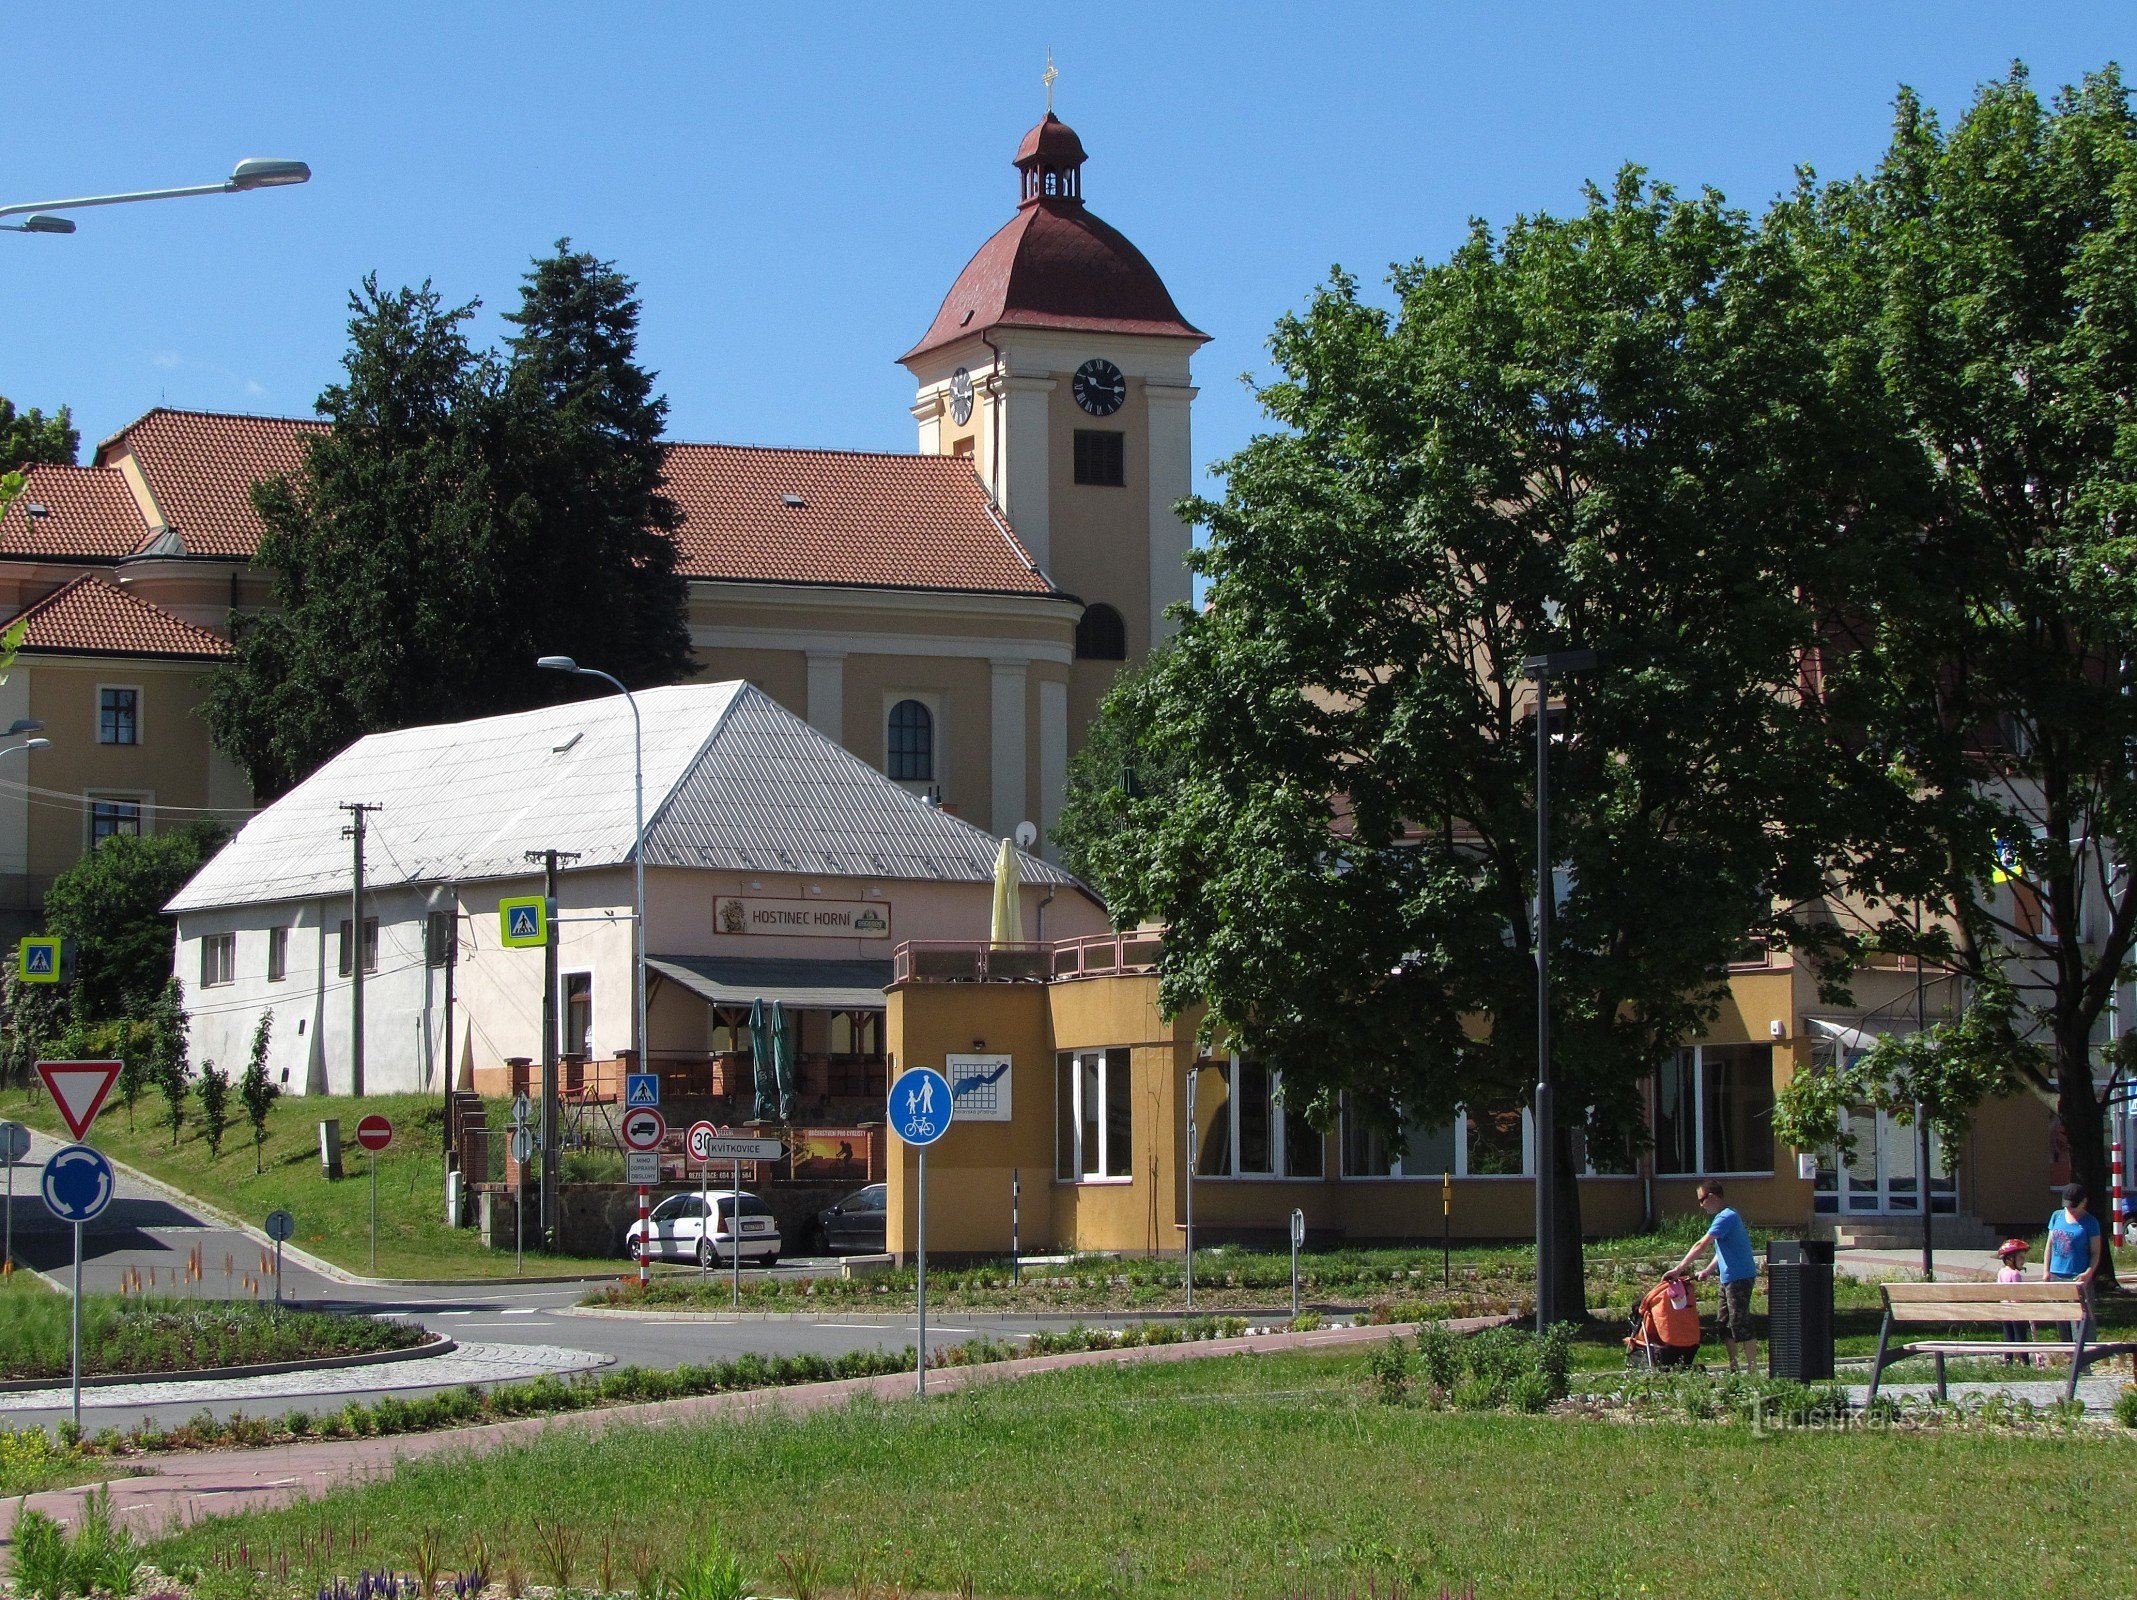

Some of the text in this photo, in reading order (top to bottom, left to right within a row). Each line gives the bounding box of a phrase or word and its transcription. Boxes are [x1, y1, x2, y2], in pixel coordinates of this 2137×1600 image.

[752, 910, 810, 925] HOSTINEC
[814, 911, 852, 926] HORNÍ
[711, 1143, 760, 1153] KVÍTKOVICE
